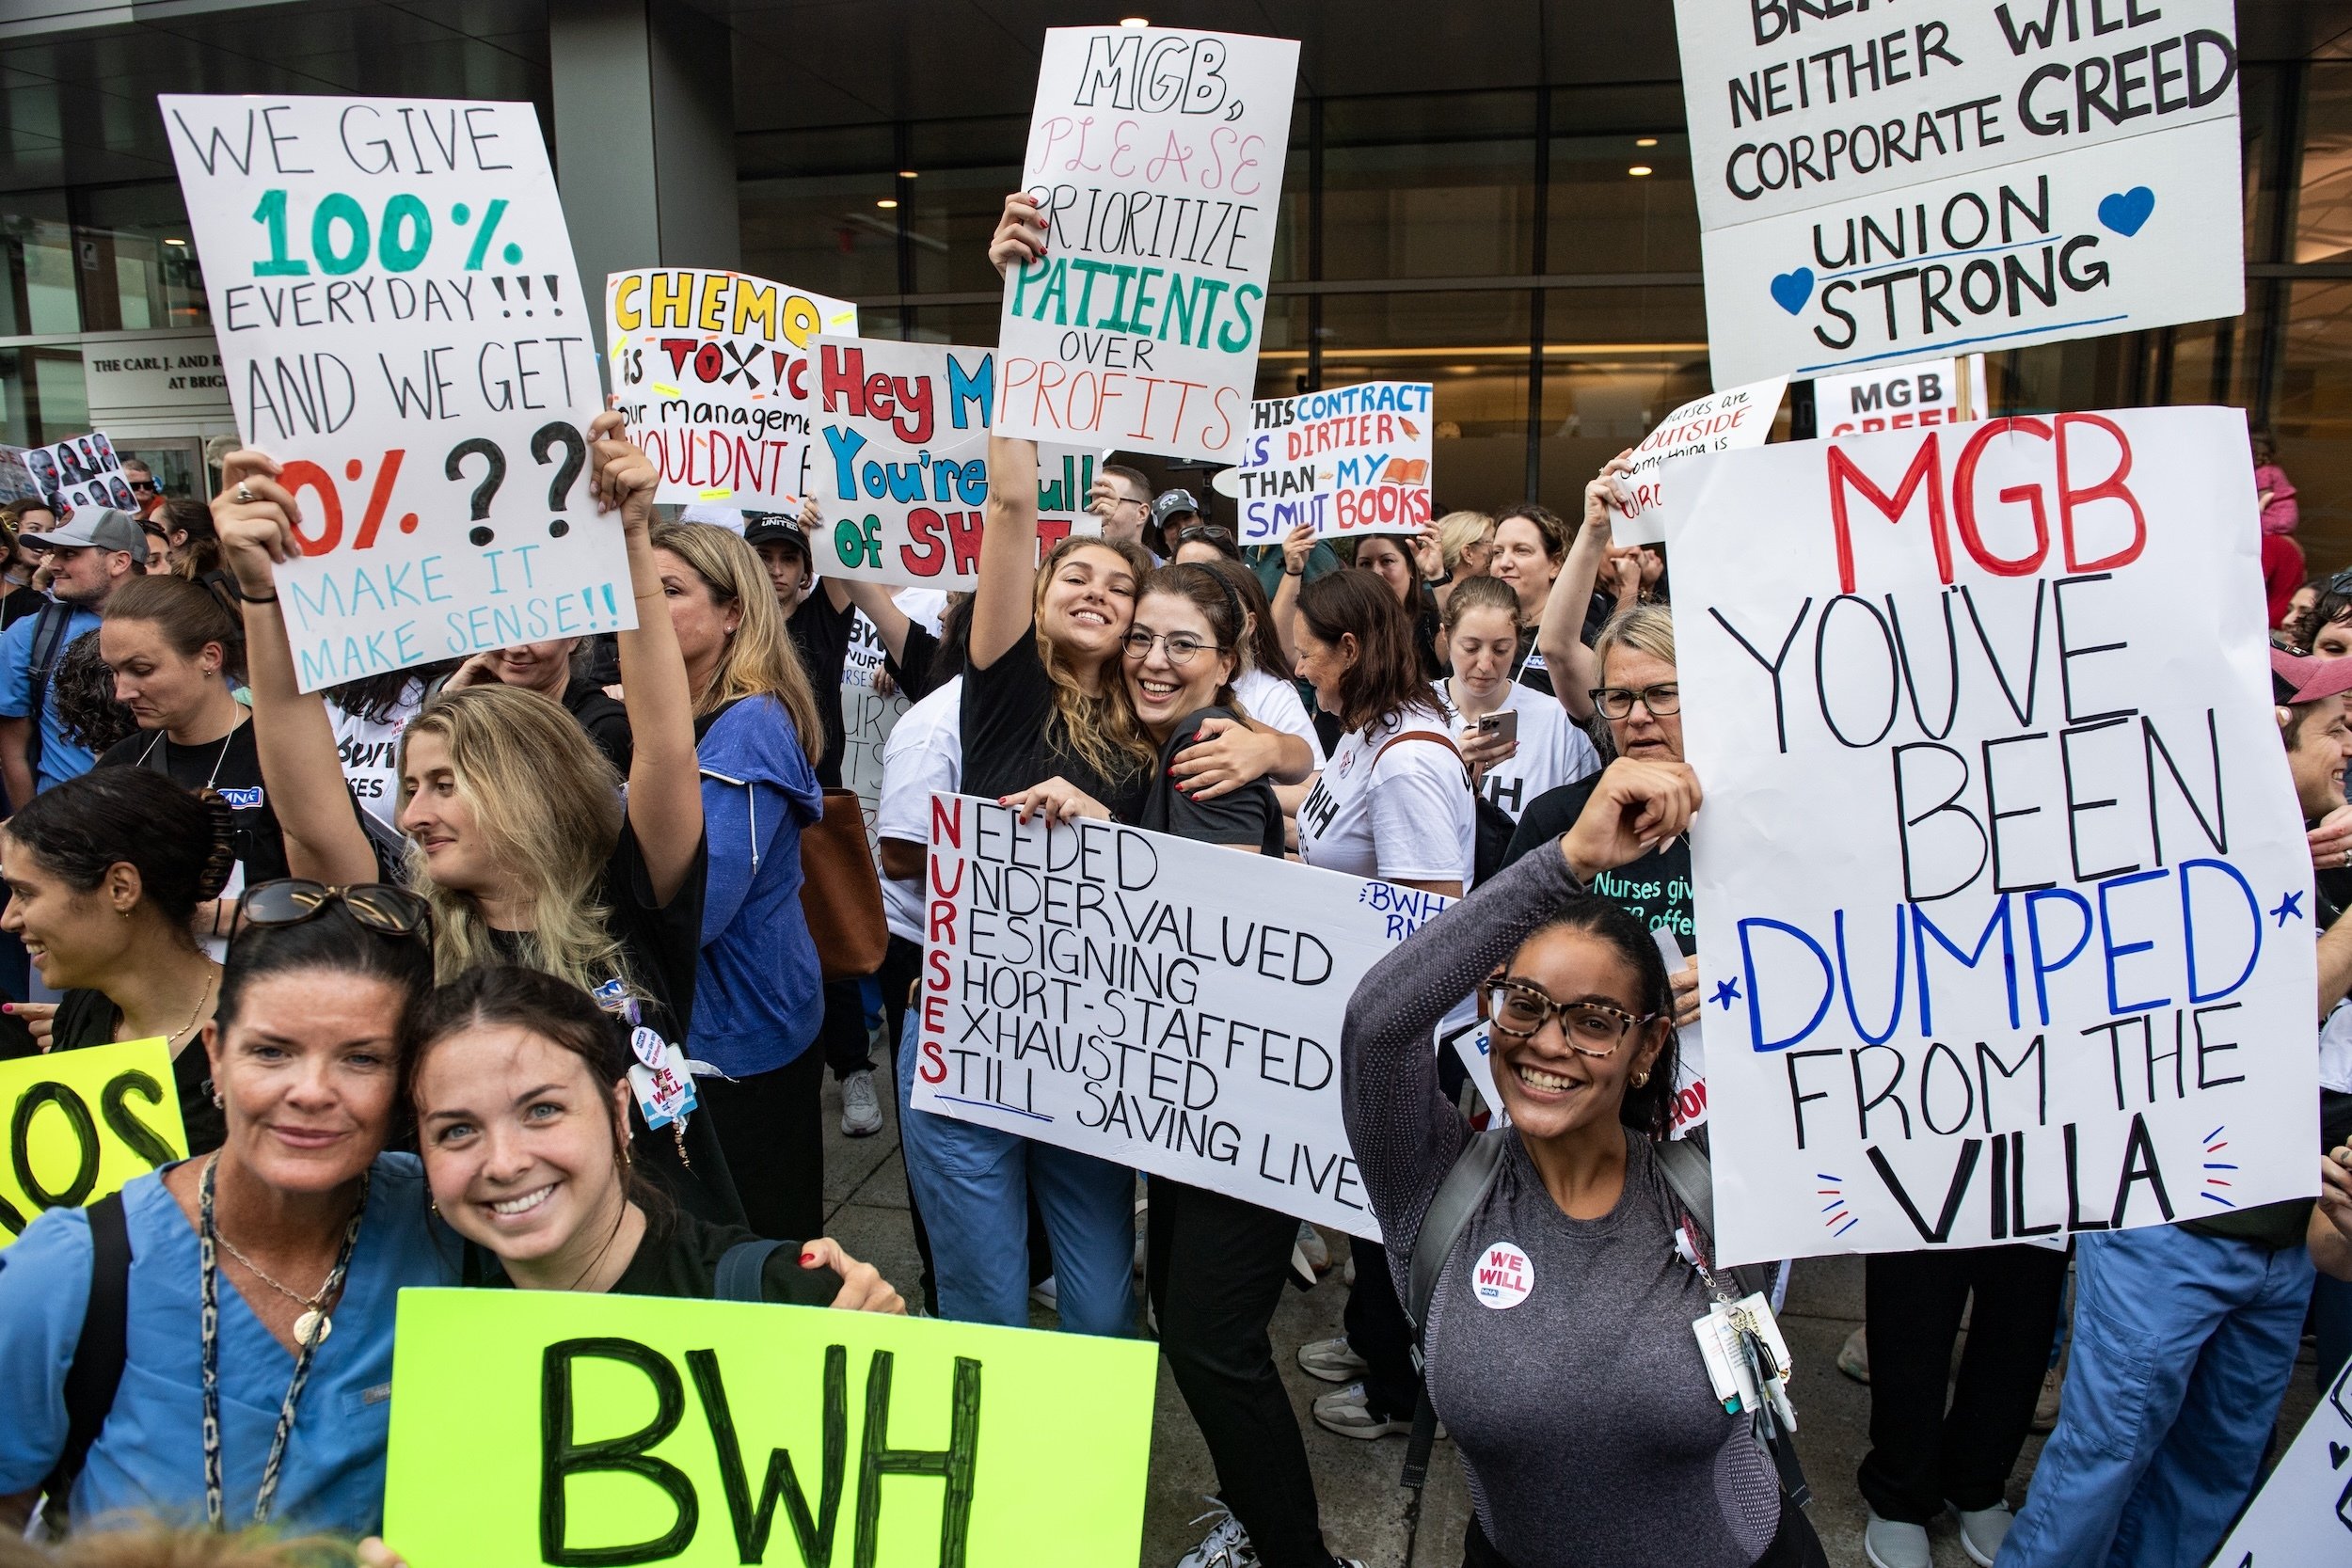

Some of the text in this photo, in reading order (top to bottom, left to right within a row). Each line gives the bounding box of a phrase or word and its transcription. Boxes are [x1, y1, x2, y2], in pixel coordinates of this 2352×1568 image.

[1073, 35, 1244, 121] MGB,
[1727, 21, 1963, 128] NEITHER
[1994, 0, 2162, 55] WILL
[173, 105, 513, 176] WE GIVE
[1032, 116, 1265, 196] PLEASE
[1724, 28, 2238, 200] CORPORATE GREED
[251, 189, 524, 277] 100%
[1813, 174, 2050, 269] UNION
[615, 272, 821, 351] CHEMO
[1010, 254, 1264, 353] PATIENTS
[1813, 235, 2110, 350] STRONG
[93, 359, 120, 372] THE
[124, 357, 161, 371] CARL
[178, 355, 209, 369] AND
[168, 375, 227, 389] AT BRIG
[248, 337, 582, 444] AND WE GET
[623, 348, 643, 386] is
[821, 344, 934, 444] Hey
[1059, 331, 1154, 372] OVER
[1851, 373, 1942, 414] MGB
[1000, 357, 1241, 451] PROFITS
[1251, 385, 1433, 430] HIS CONTRACT
[1288, 414, 1393, 461] DIRTIER
[1641, 405, 1753, 451] OUTSIDE
[1715, 436, 1728, 451] is
[1721, 392, 1750, 409] are
[625, 427, 789, 496] OULDN'T
[821, 424, 988, 506] You're
[1038, 454, 1093, 512] ull
[1239, 453, 1389, 499] THAN MY
[1827, 413, 2147, 594] MGB
[834, 514, 882, 568] of
[1246, 486, 1432, 538] SMUT BOOKS
[291, 544, 540, 631] MAKE IT
[300, 581, 620, 689] MAKE SENSE!!
[1303, 776, 1341, 840] WH
[1892, 707, 2227, 903] BEEN
[931, 853, 1333, 986] UNDERVALUED
[1366, 881, 1445, 920] BWH
[1593, 871, 1693, 906] Nurses giv
[930, 900, 1200, 1006] RESIGNING
[1738, 860, 2263, 1053] DUMPED
[924, 995, 1218, 1111] EXHAUSTED
[1785, 1002, 2246, 1148] FROM THE
[919, 1041, 1378, 1220] STILL SAVING LIVE
[1867, 1112, 2175, 1243] VILLA
[1479, 1268, 1527, 1292] WILL
[1490, 1251, 1524, 1273] WE
[539, 1338, 982, 1568] BWH
